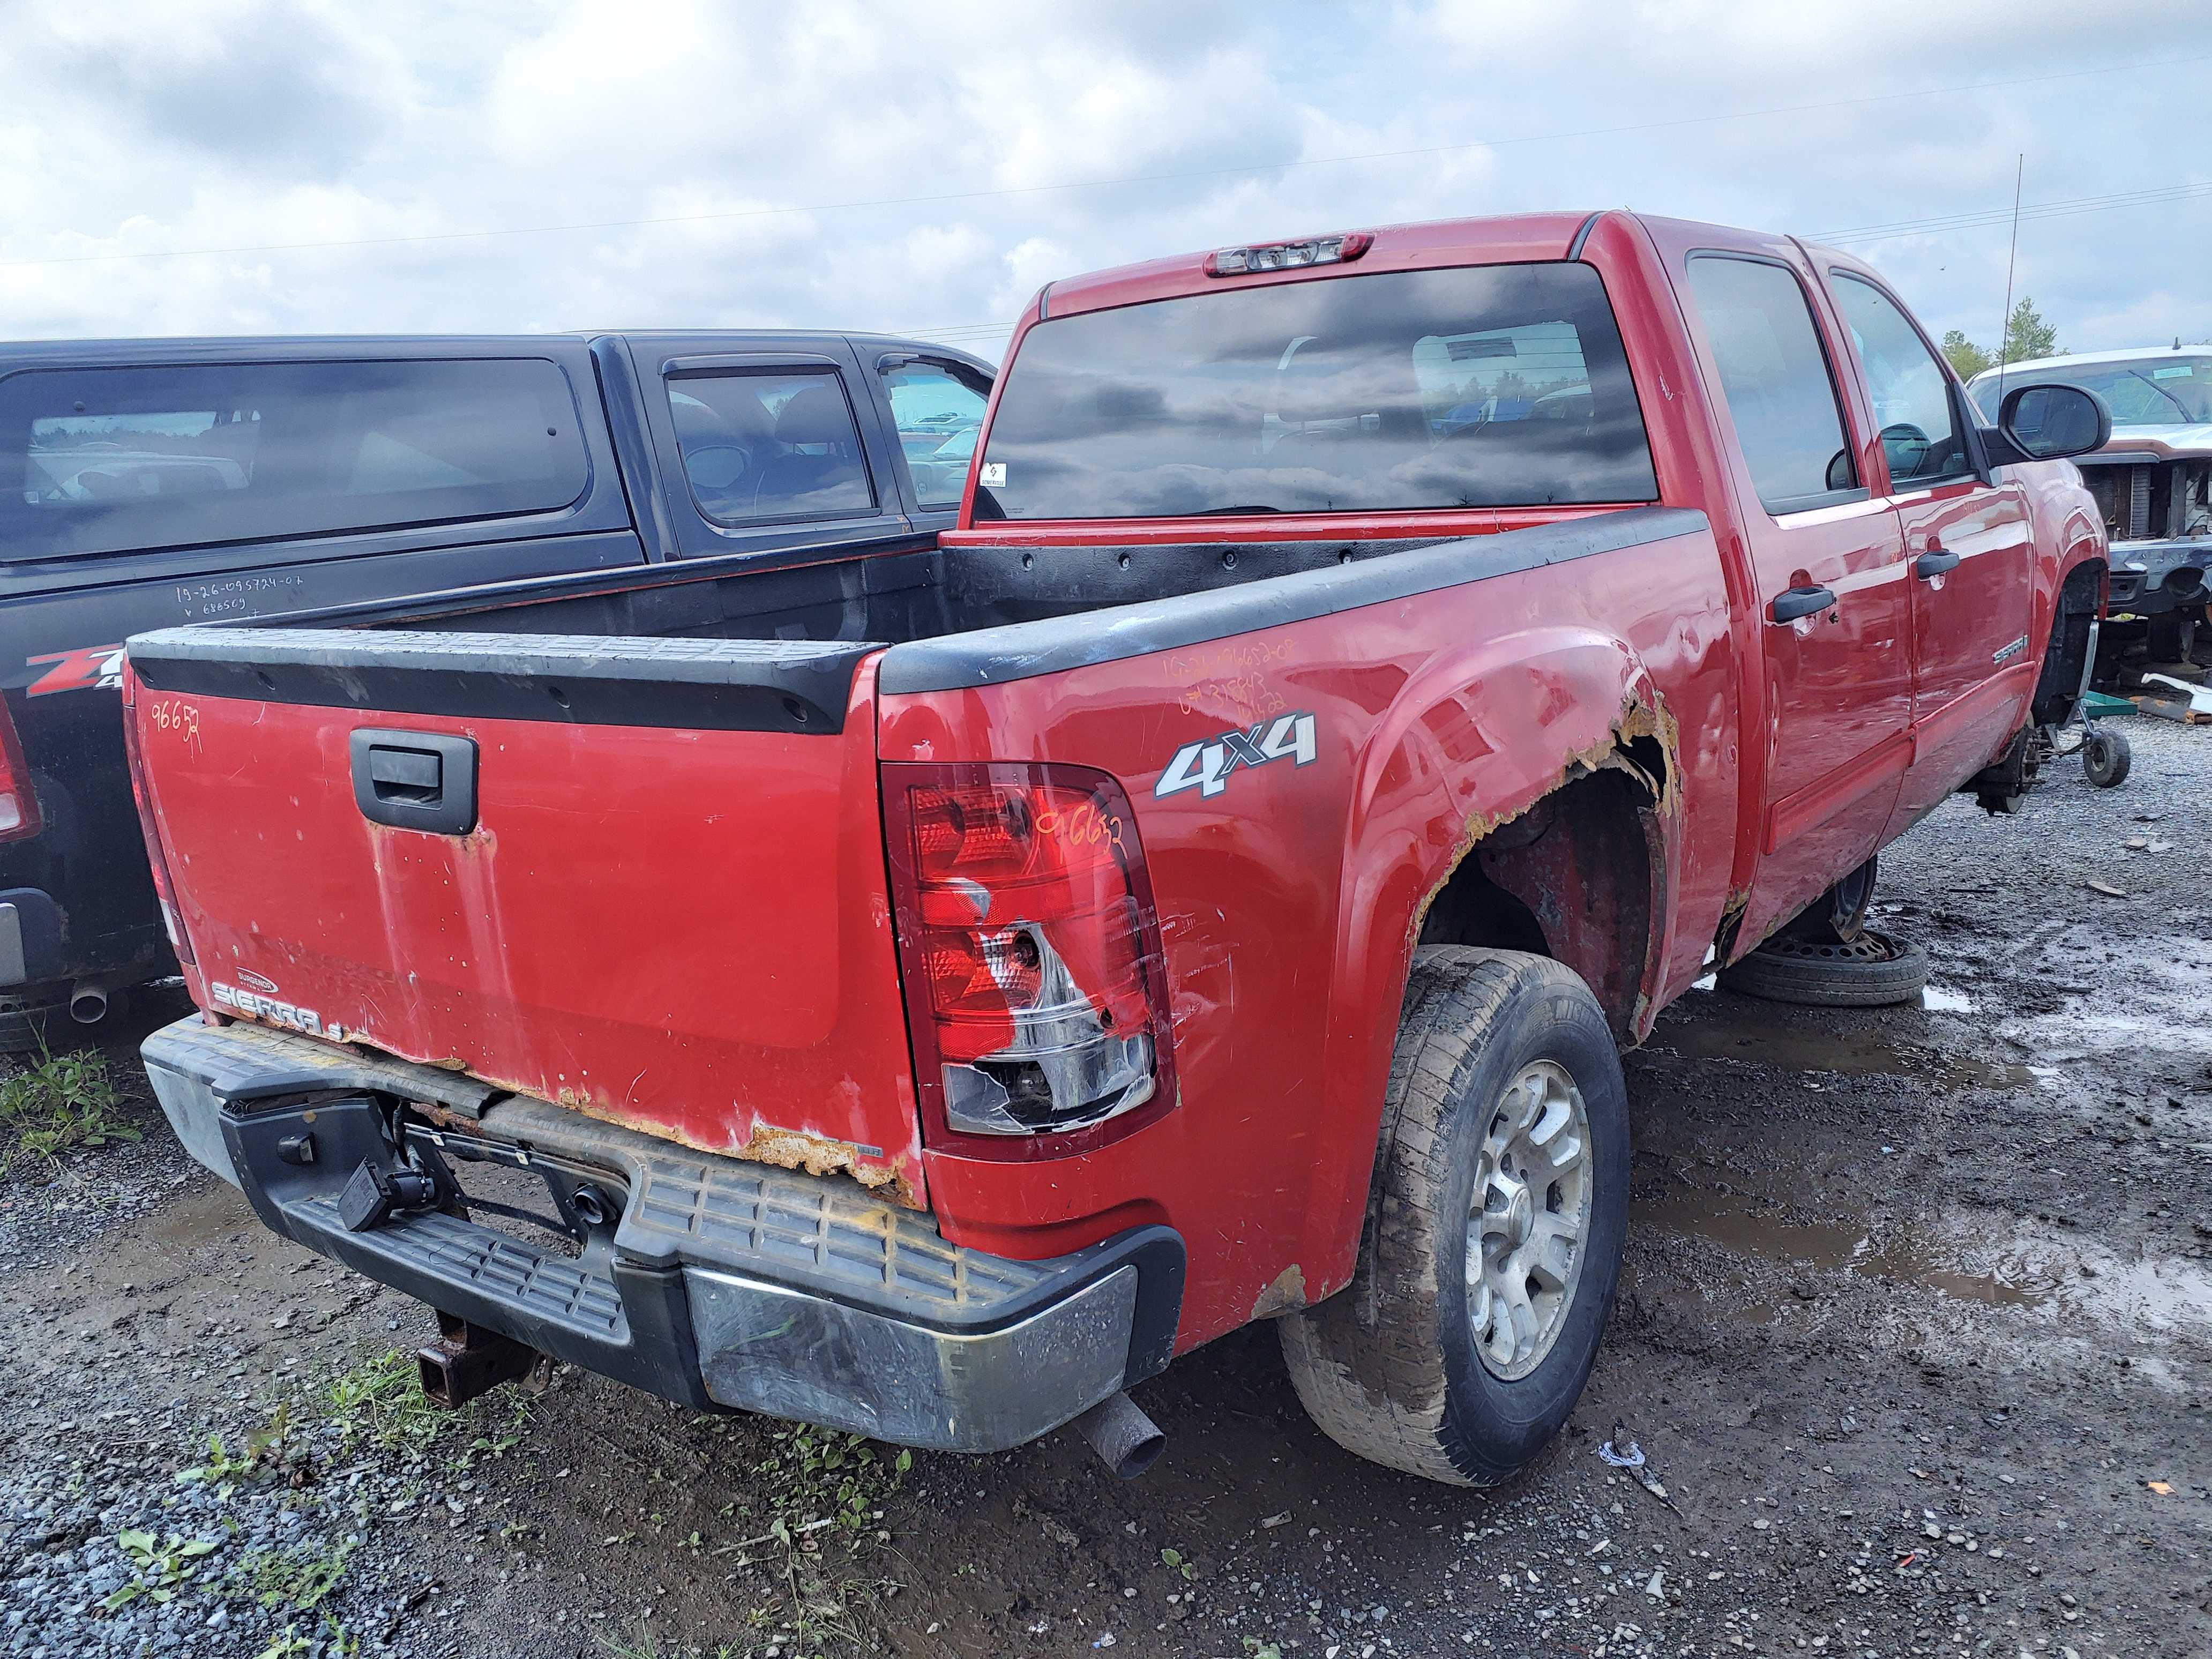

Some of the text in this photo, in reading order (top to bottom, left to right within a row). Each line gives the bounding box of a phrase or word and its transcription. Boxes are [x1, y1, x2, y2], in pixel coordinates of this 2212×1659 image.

[1035, 804, 1127, 864] 96652
[211, 981, 324, 1034] SIERRA
[237, 972, 272, 990] SURGENOR
